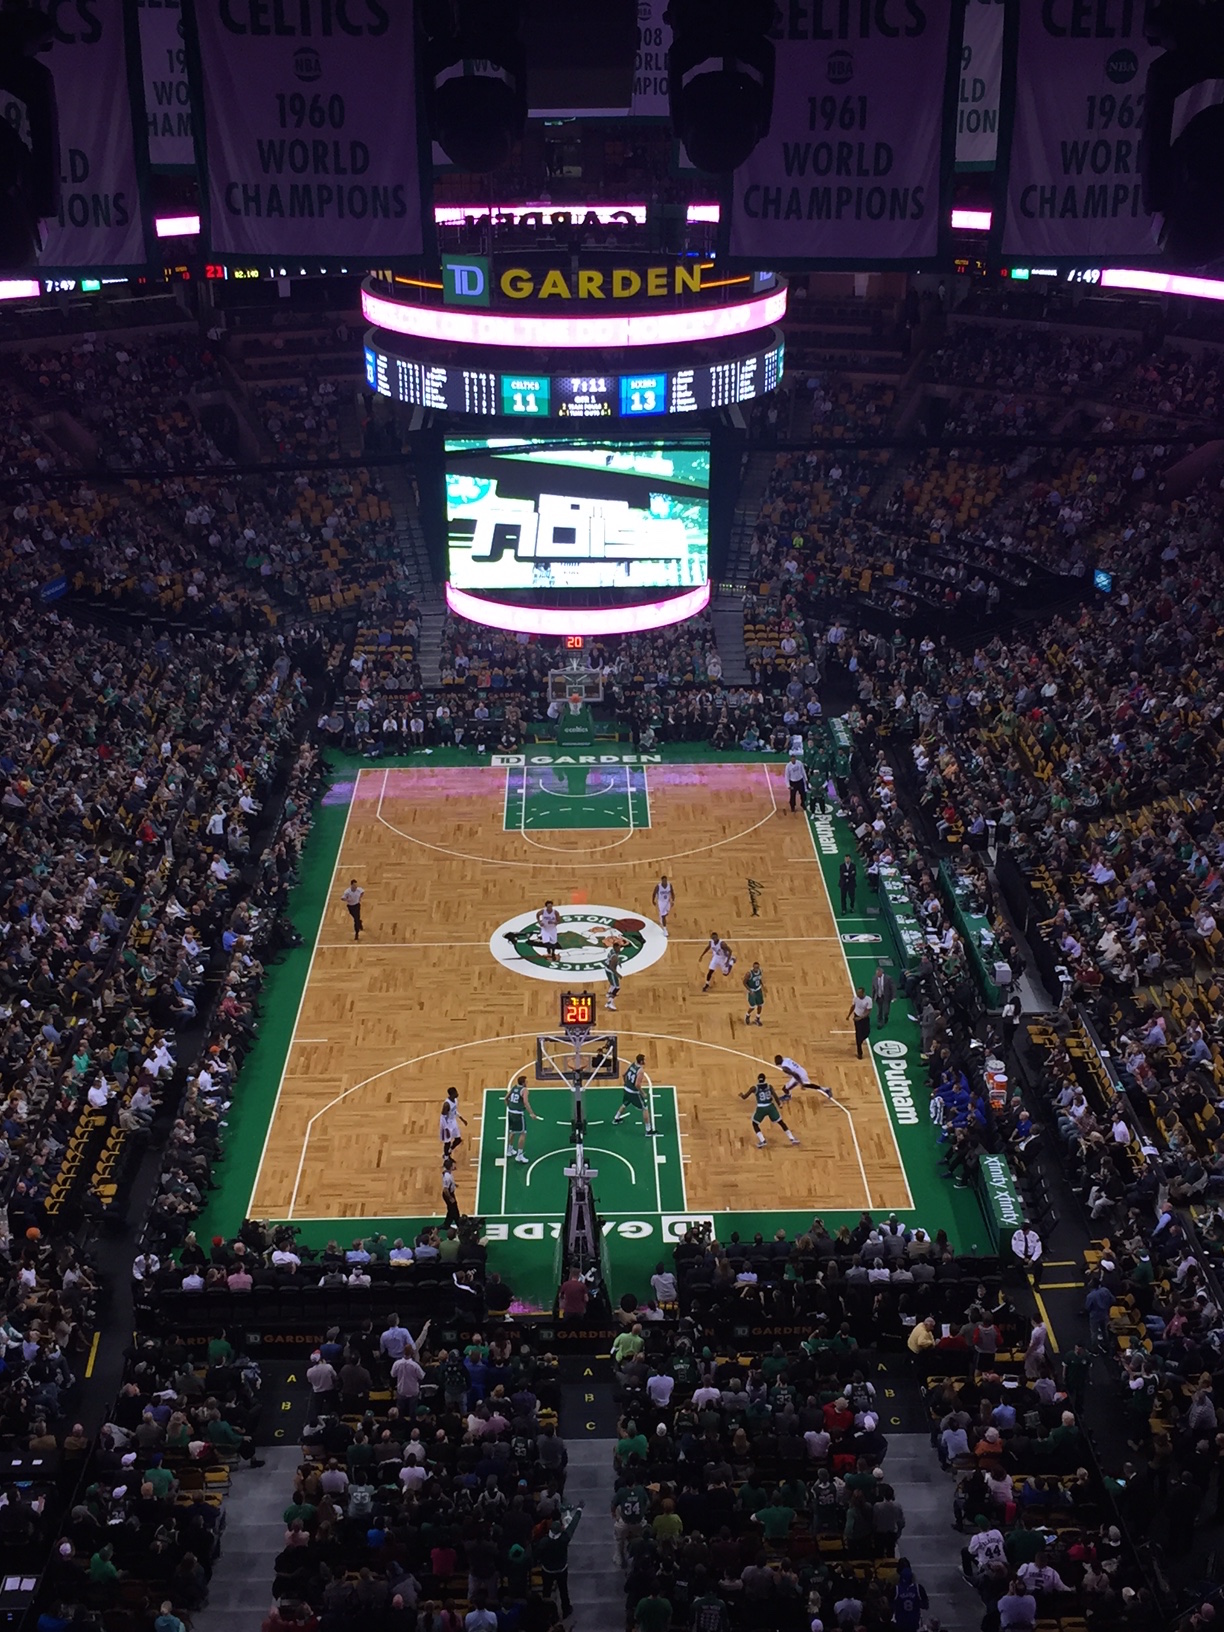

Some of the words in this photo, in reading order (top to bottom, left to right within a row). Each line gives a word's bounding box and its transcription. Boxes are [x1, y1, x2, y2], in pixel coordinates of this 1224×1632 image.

[1108, 60, 1136, 73] NBA
[276, 93, 345, 129] 1960
[808, 95, 868, 131] 1961
[257, 139, 371, 175] WORLD
[782, 141, 893, 177] WORLD
[225, 182, 407, 219] CHAMPIONS
[743, 184, 924, 221] CHAMPIONS
[446, 264, 485, 296] TD
[500, 264, 701, 300] GARDEN
[571, 378, 607, 392] 7:11
[513, 393, 539, 412] 11
[631, 391, 657, 411] 13
[567, 636, 582, 648] 20
[500, 756, 522, 765] TD
[530, 753, 662, 765] GARDEN
[814, 814, 839, 855] Putnam
[570, 996, 592, 1006] 7:11
[566, 1006, 589, 1022] 20
[880, 1059, 920, 1126] Putnam
[984, 1156, 1008, 1195] xfinity
[993, 1191, 1020, 1227] xfinity
[557, 1329, 617, 1340] GARDEN
[751, 1325, 811, 1336] GARDEN
[264, 1333, 324, 1344] GARDEN
[583, 1367, 594, 1377] A
[877, 1362, 888, 1372] A
[286, 1374, 297, 1384] A
[584, 1393, 595, 1404] B
[885, 1388, 896, 1399] B
[281, 1401, 292, 1412] B
[585, 1421, 596, 1431] C
[274, 1429, 285, 1439] C
[353, 1492, 369, 1504] 33
[624, 1502, 640, 1515] 34
[985, 1545, 1001, 1559] 44
